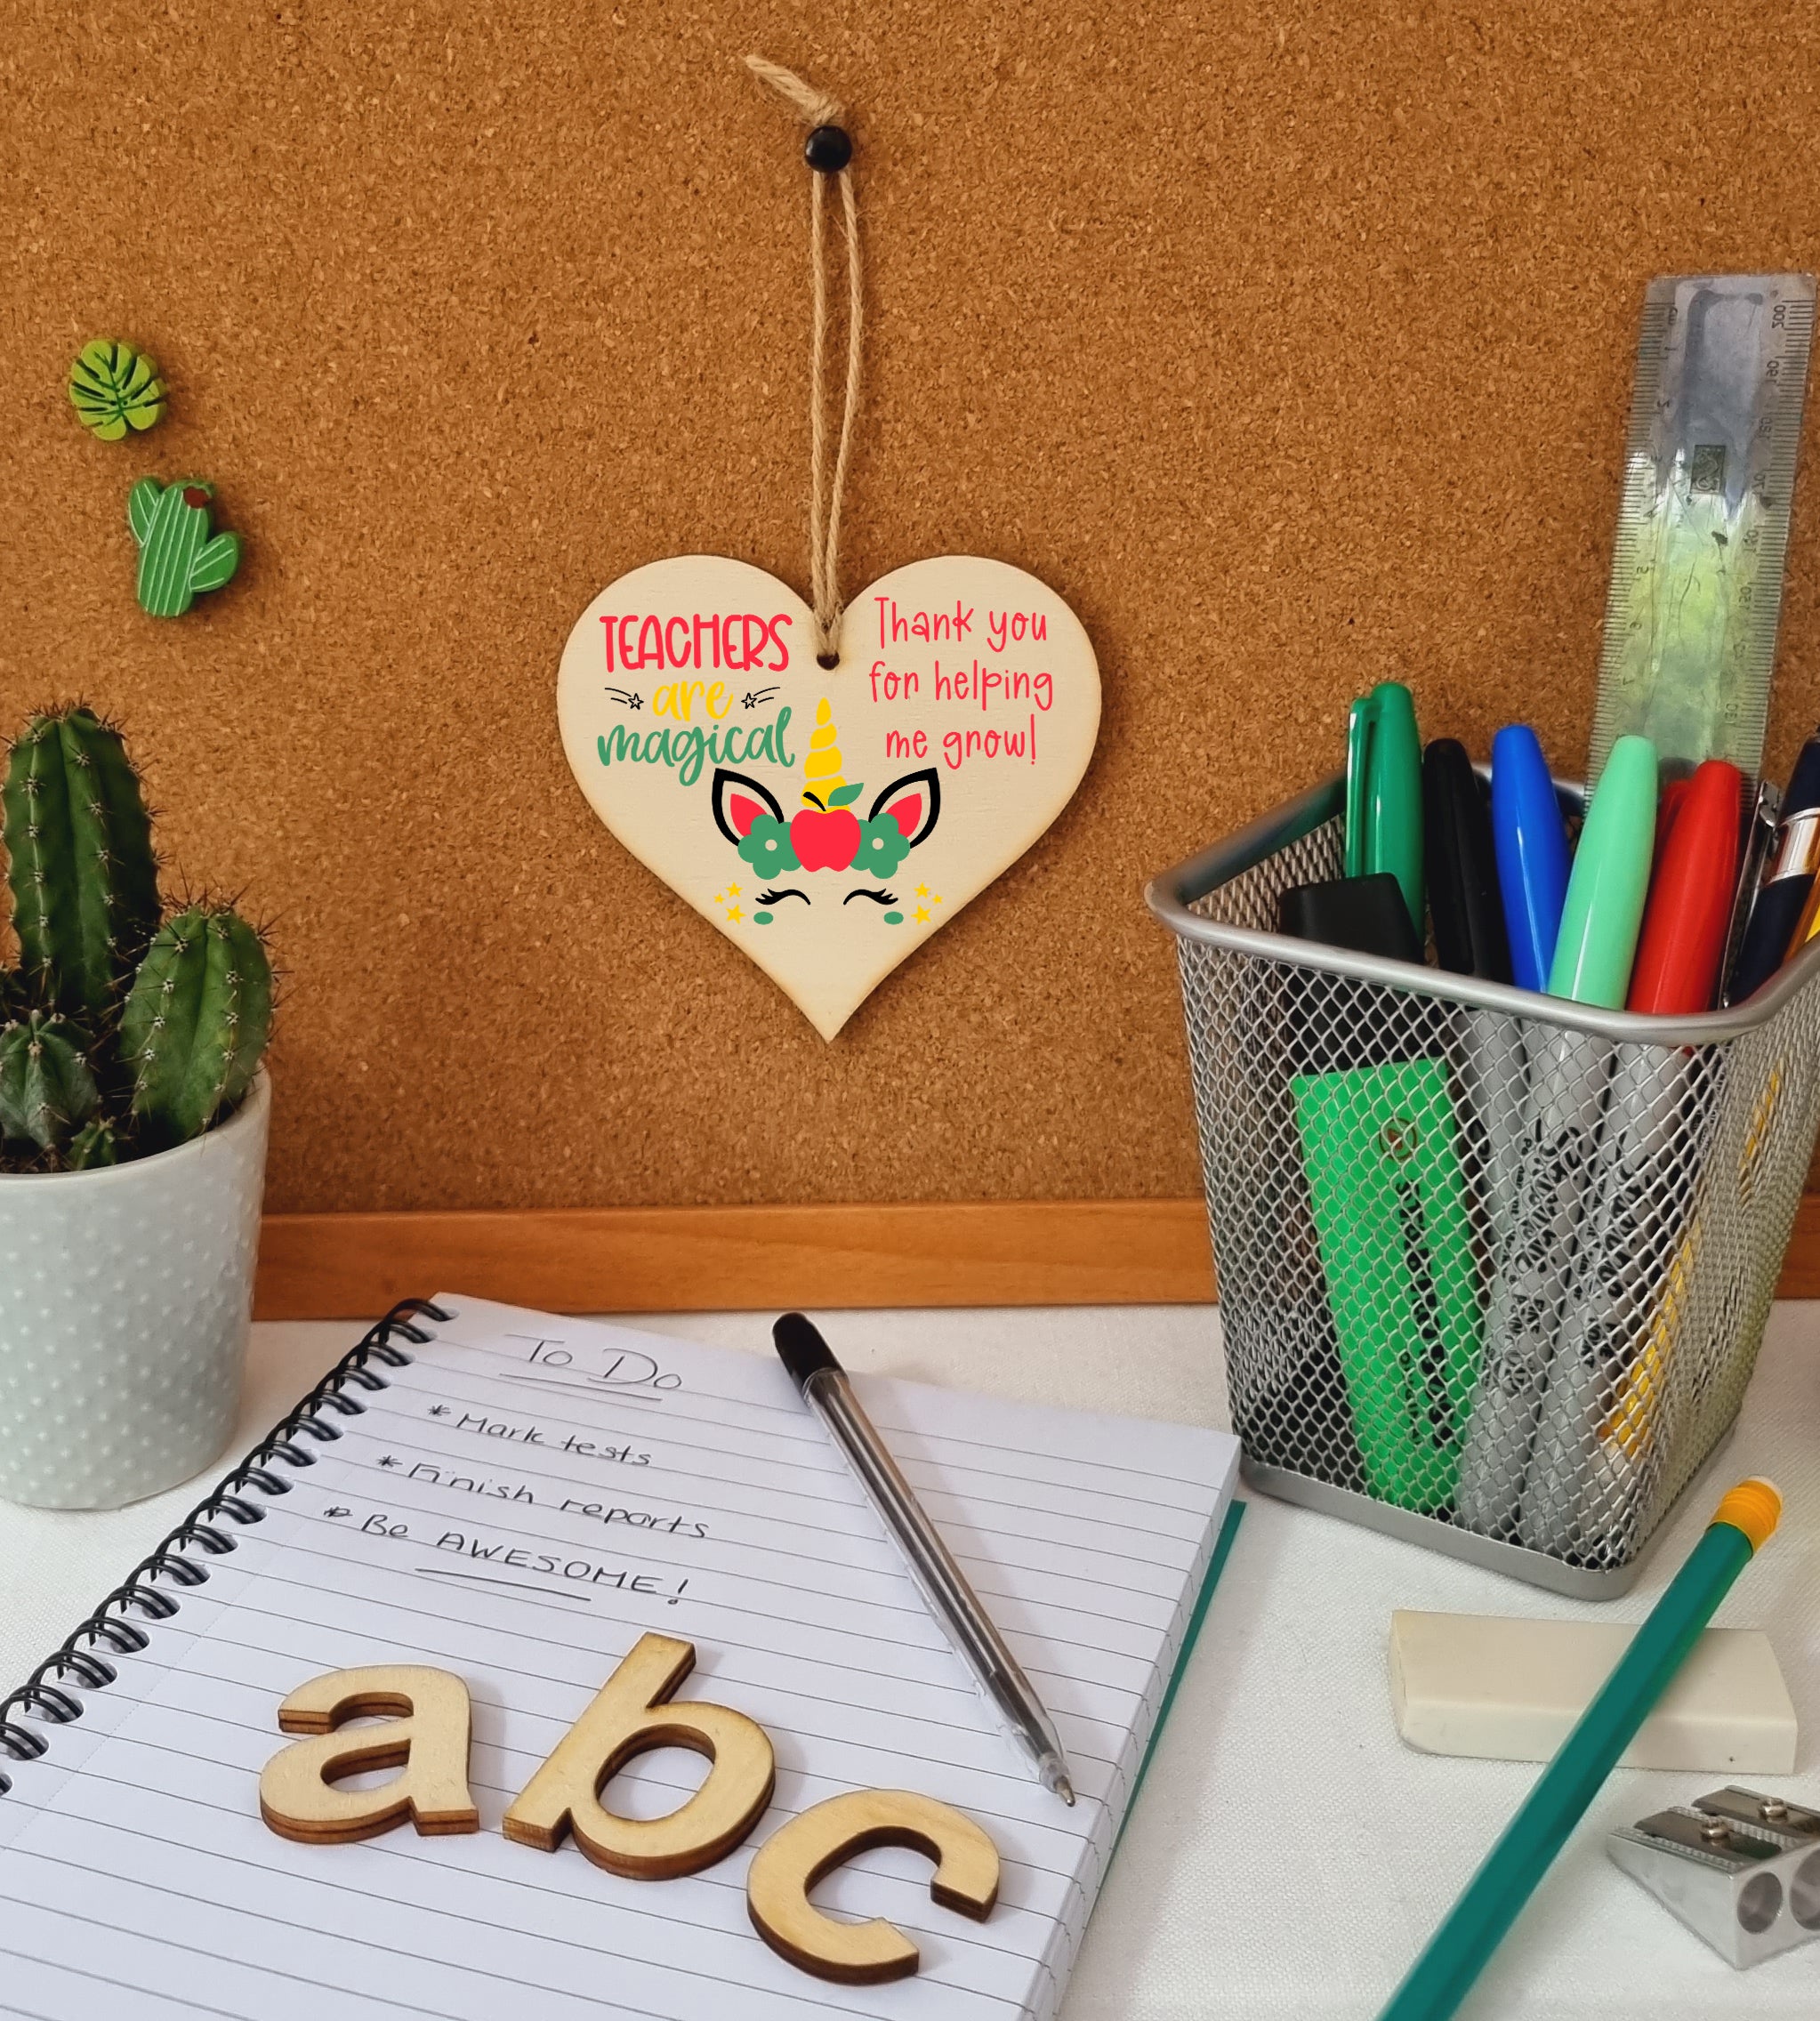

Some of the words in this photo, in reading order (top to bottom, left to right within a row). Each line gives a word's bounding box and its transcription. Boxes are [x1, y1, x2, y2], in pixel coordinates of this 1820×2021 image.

[600, 614, 793, 672] TEACHERS
[874, 597, 974, 649] Thank
[987, 611, 1047, 653] you
[653, 680, 734, 721] are
[869, 661, 919, 703] for
[935, 660, 1053, 712] helping
[597, 706, 795, 787] magical
[886, 729, 928, 759] me
[943, 714, 1037, 770] grow!
[1508, 1137, 1534, 1215] Pemannt
[504, 1333, 573, 1366] To
[587, 1348, 683, 1390] Do
[455, 1413, 545, 1445] Mark
[560, 1434, 652, 1467] tests
[359, 1513, 409, 1539] Be
[407, 1461, 535, 1505] Finish
[559, 1497, 711, 1540] reports
